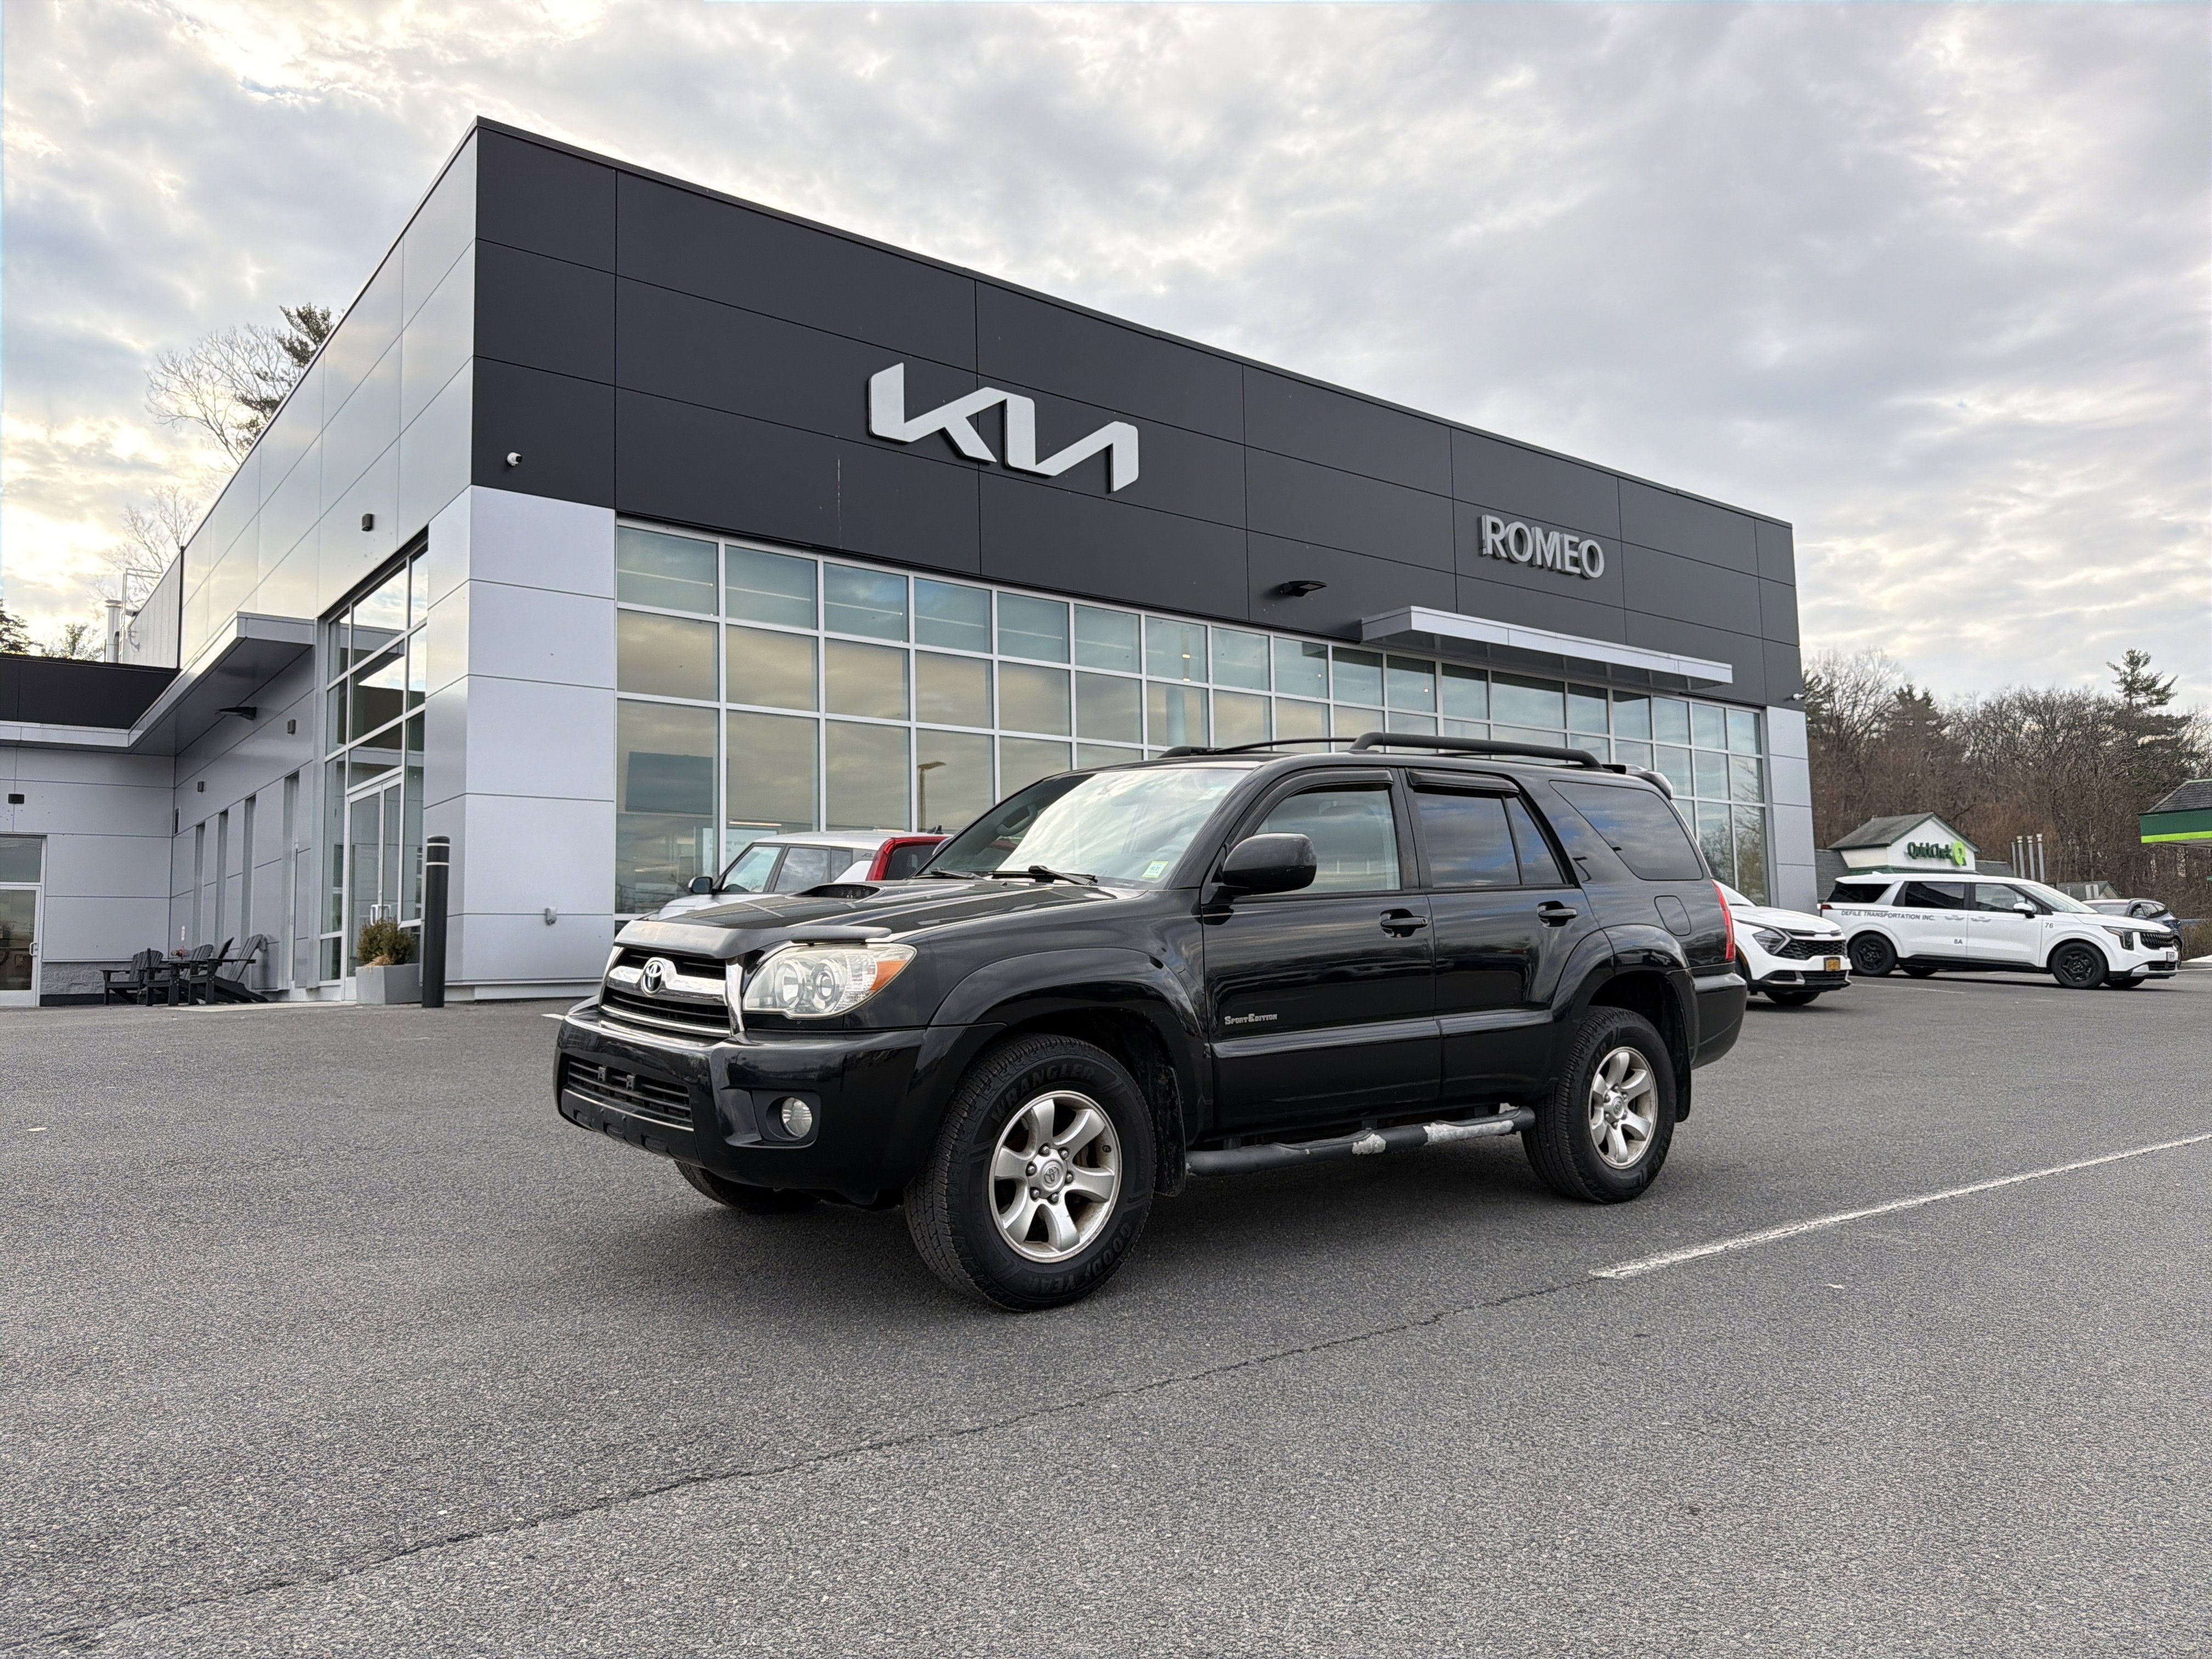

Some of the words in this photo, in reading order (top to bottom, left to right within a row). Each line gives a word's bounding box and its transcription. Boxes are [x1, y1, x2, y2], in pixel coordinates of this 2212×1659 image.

[869, 362, 1139, 493] KIA
[1481, 514, 1605, 579] ROMEO
[1864, 911, 1920, 920] TRANSPORTATION
[991, 1063, 1096, 1125] WRANGLER
